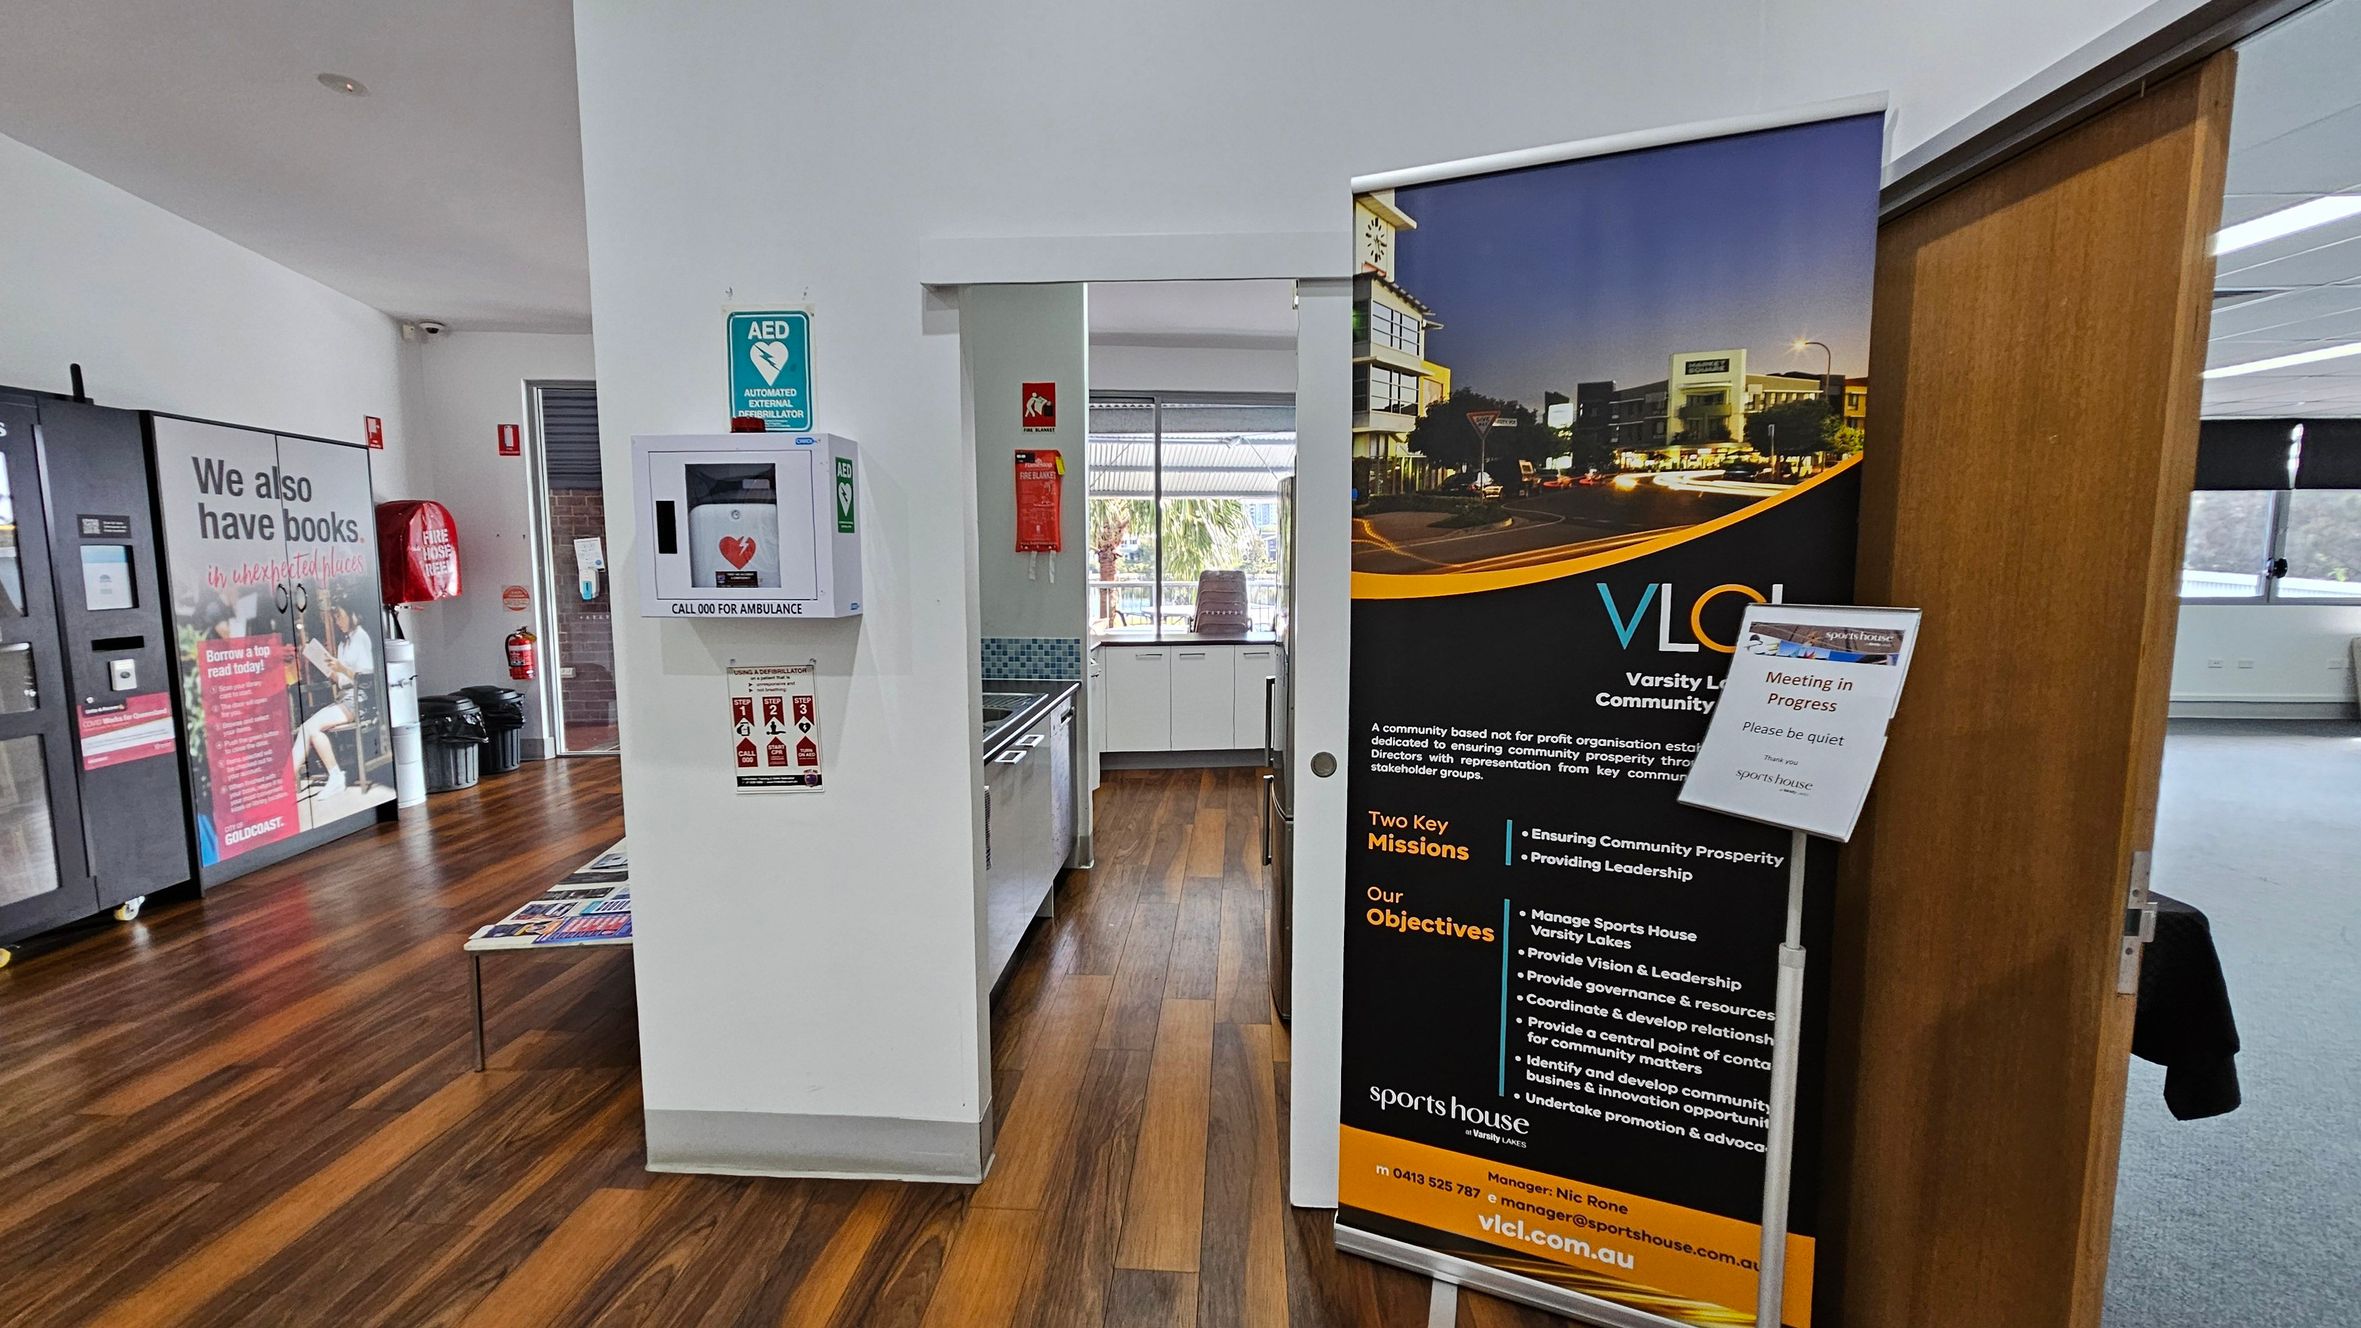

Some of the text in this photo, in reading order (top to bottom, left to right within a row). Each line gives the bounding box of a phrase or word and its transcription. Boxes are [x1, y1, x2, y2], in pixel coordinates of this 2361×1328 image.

[748, 320, 790, 340] AED
[744, 389, 797, 397] AUTOMATED
[749, 399, 793, 408] EXTERNAL
[738, 409, 804, 418] DEFIBRILLATOR
[192, 456, 312, 502] We also
[837, 462, 852, 478] AED
[1020, 471, 1056, 480] FIRE BLANKET
[198, 502, 365, 543] have books.
[423, 529, 448, 544] FIRE
[208, 546, 364, 597] in unexpected places
[672, 603, 802, 615] CALL 000 FOR AMBULANCE
[1826, 631, 1894, 641] sports house
[206, 645, 270, 662] Borrow a top
[208, 659, 265, 678] read today!
[1626, 672, 1702, 691] Varsity
[1765, 671, 1853, 691] Meeting in
[740, 705, 746, 716] 1
[769, 705, 777, 715] 2
[800, 704, 807, 714] 3
[1595, 692, 1715, 714] Community
[1767, 692, 1838, 713] Progress
[1371, 723, 1380, 732] A
[1383, 724, 1448, 737] community
[1451, 727, 1487, 739] based
[1491, 729, 1511, 740] not
[1515, 731, 1533, 742] for
[1537, 733, 1573, 744] profit
[1576, 737, 1661, 751] organisation
[1742, 721, 1845, 747] Please be quiet
[1371, 736, 1429, 748] dedicated
[1434, 739, 1446, 749] to
[1451, 742, 1503, 756] ensuring
[1507, 747, 1580, 761] community
[1585, 752, 1655, 766] prosperity
[1764, 754, 1783, 762] Thank
[1371, 749, 1688, 782] Directors with representation from key commun
[1371, 763, 1484, 781] stakeholder groups.
[1736, 769, 1813, 791] sports house
[1369, 810, 1449, 835] Two Key
[1368, 833, 1470, 861] Missions
[1531, 827, 1784, 868] Ensuring Community Prosperity
[1531, 852, 1693, 882] Providing Leadership
[1367, 886, 1404, 903] Our
[1366, 908, 1495, 942] Objectives
[1530, 924, 1632, 950] Varsity Lakes
[1531, 909, 1698, 942] Manage Sports House
[1527, 947, 1742, 991] Provide Vision & Leadership
[1527, 970, 1776, 1021] Provide governance & resources
[1526, 993, 1774, 1046] Coordinate & develop relationsh
[1527, 1016, 1771, 1071] Provide a central point of conta
[1527, 1031, 1703, 1075] for community matters
[1527, 1054, 1583, 1075] Identify
[1585, 1065, 1615, 1082] and
[1617, 1073, 1678, 1095] develop
[1370, 1086, 1530, 1135] sports house
[1526, 1070, 1769, 1129] busines & innovation opportunit
[1525, 1092, 1768, 1153] Undertake promotion & advoca
[1473, 1129, 1501, 1144] Varsity
[1502, 1137, 1527, 1149] LAKES
[1376, 1164, 1390, 1176] m
[1393, 1168, 1425, 1185] 0413
[1428, 1176, 1452, 1192] 525
[1457, 1183, 1481, 1199] 787
[1487, 1193, 1497, 1204] e
[1488, 1171, 1629, 1215] Manager: Nic Rone
[1478, 1214, 1635, 1270] vlcl.com.au
